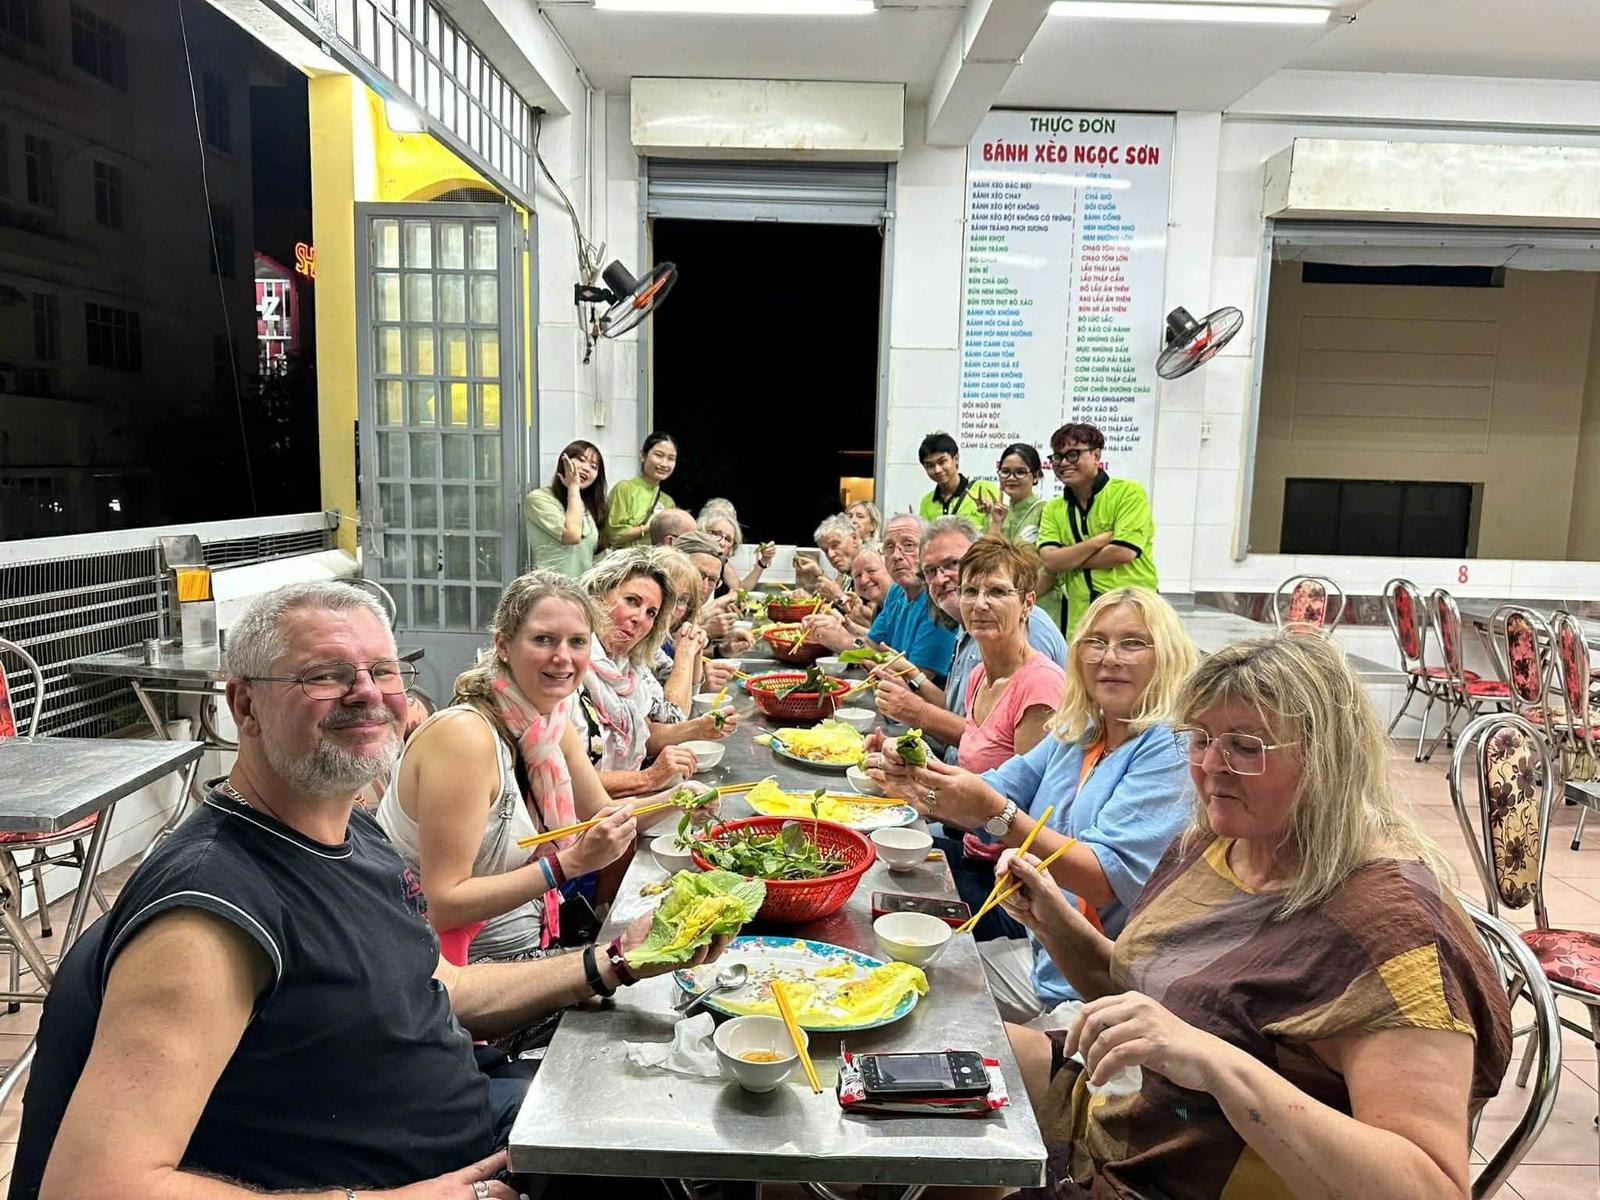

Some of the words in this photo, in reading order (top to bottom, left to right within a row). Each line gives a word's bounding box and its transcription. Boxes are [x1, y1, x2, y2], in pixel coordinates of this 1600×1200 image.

[1030, 118, 1073, 136] THỰC
[1079, 117, 1115, 133] ĐƠN
[983, 139, 1028, 162] BÁNH
[1035, 140, 1067, 162] XÈO
[1075, 145, 1119, 168] NGỌC
[1125, 146, 1159, 165] SƠN
[1459, 565, 1468, 583] 8
